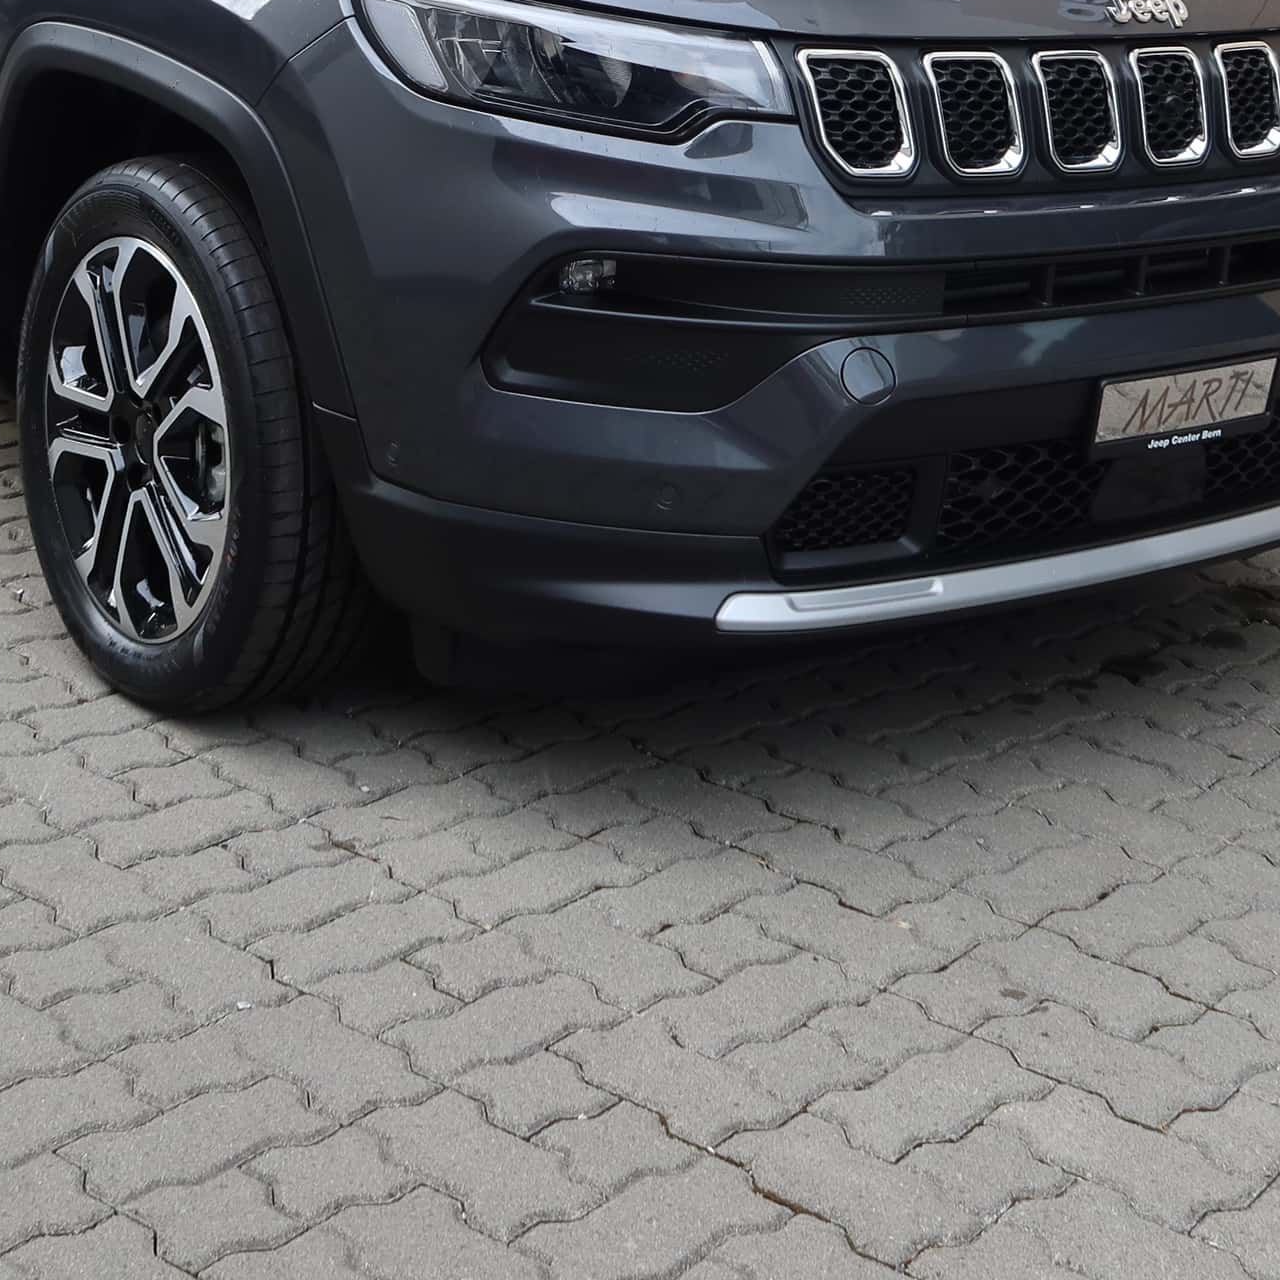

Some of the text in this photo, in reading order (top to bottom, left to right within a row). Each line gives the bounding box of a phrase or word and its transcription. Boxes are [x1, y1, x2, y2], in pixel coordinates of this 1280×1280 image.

[1122, 369, 1255, 433] MARTI
[1147, 429, 1222, 449] Jeep Center Bern
